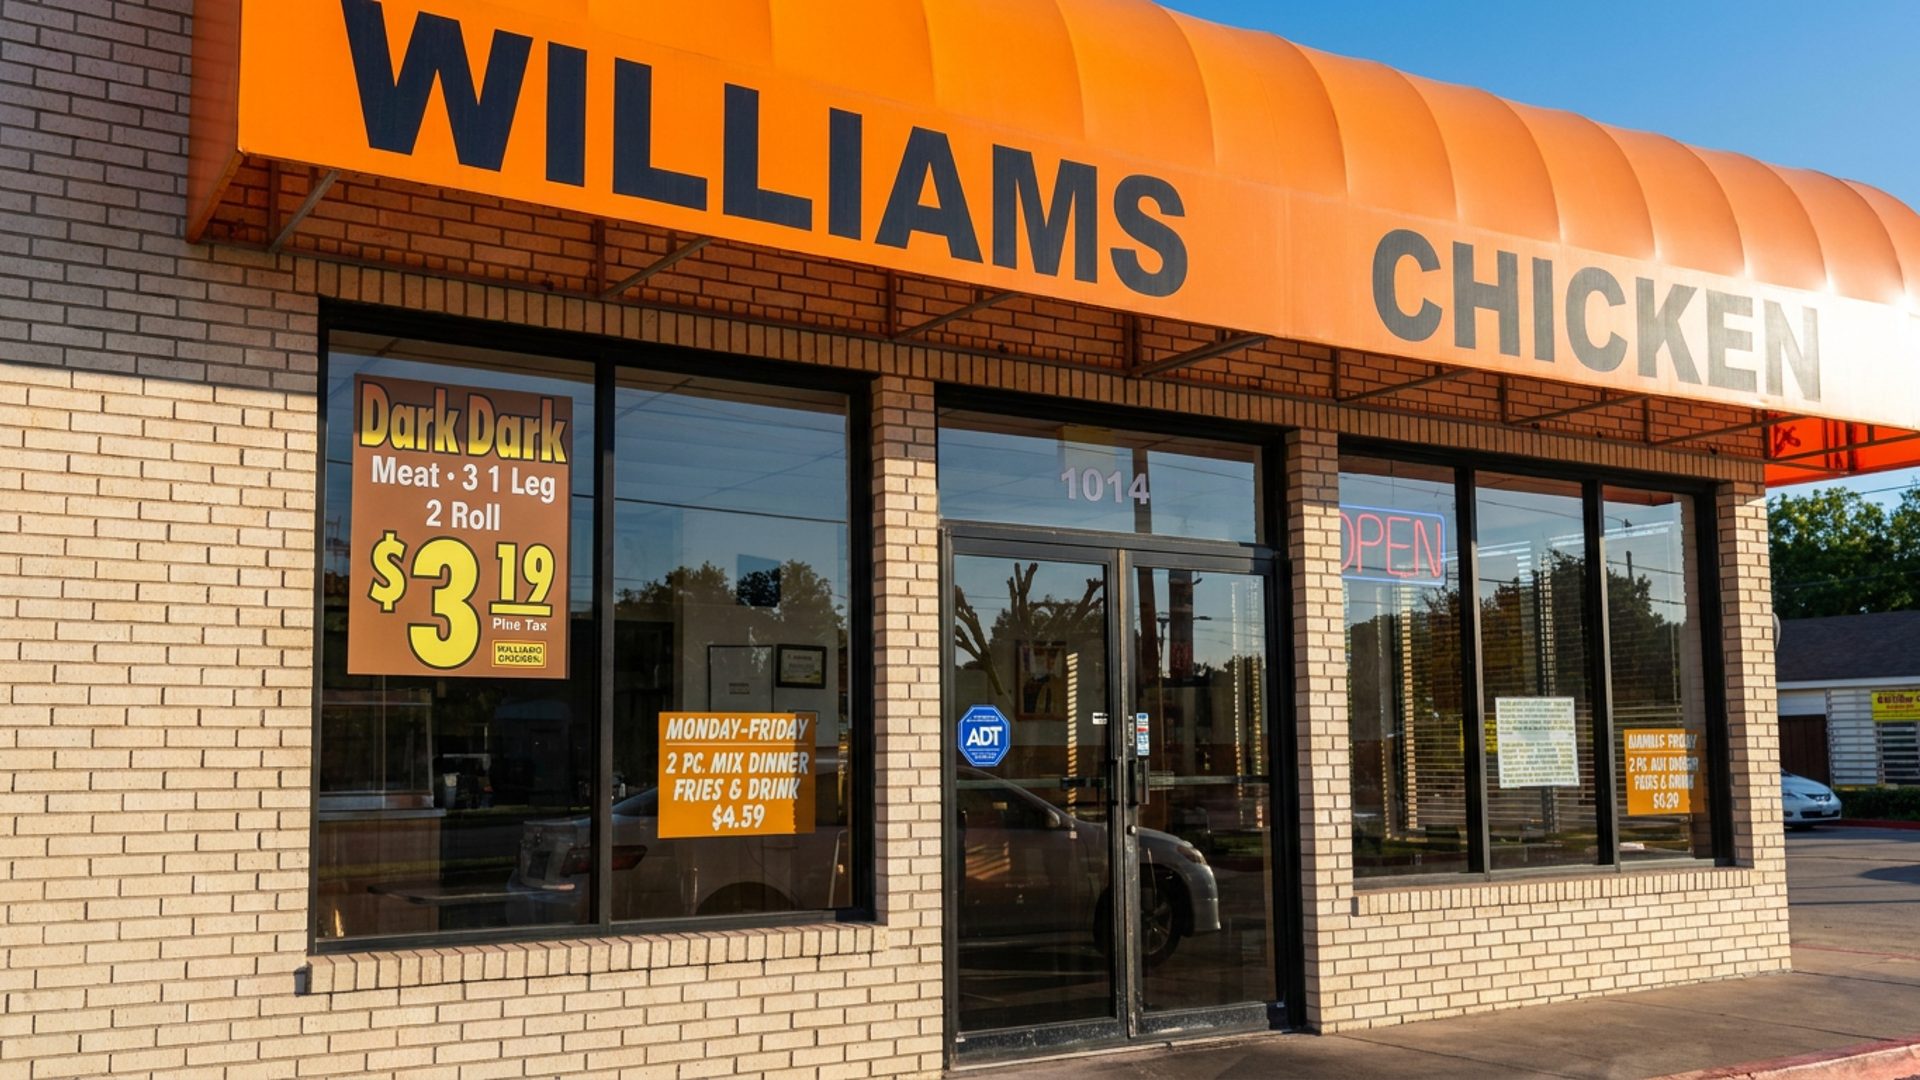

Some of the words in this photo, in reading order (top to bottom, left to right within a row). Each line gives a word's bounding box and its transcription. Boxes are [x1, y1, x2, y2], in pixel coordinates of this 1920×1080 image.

[341, 0, 1189, 299] WILLIAMS
[1371, 228, 1821, 402] CHICKEN
[360, 380, 461, 455] Dark
[466, 392, 567, 464] Dark
[371, 455, 440, 488] Meat
[462, 463, 478, 492] 3
[488, 465, 499, 493] 1
[511, 467, 556, 504] Leg
[1060, 467, 1150, 505] 1014
[425, 499, 442, 527] 2
[451, 501, 501, 531] Roll
[496, 542, 556, 604] 19
[525, 619, 547, 631] Tax
[665, 718, 809, 741] MONDAY-FRIDAY
[966, 726, 1003, 746] ADT
[665, 752, 678, 774] 2
[682, 752, 706, 774] PC.
[710, 752, 744, 774] MIX
[748, 751, 809, 775] DINNER
[673, 778, 724, 802] FRIES
[748, 777, 801, 801] DRINK
[711, 804, 765, 831] $4.59
